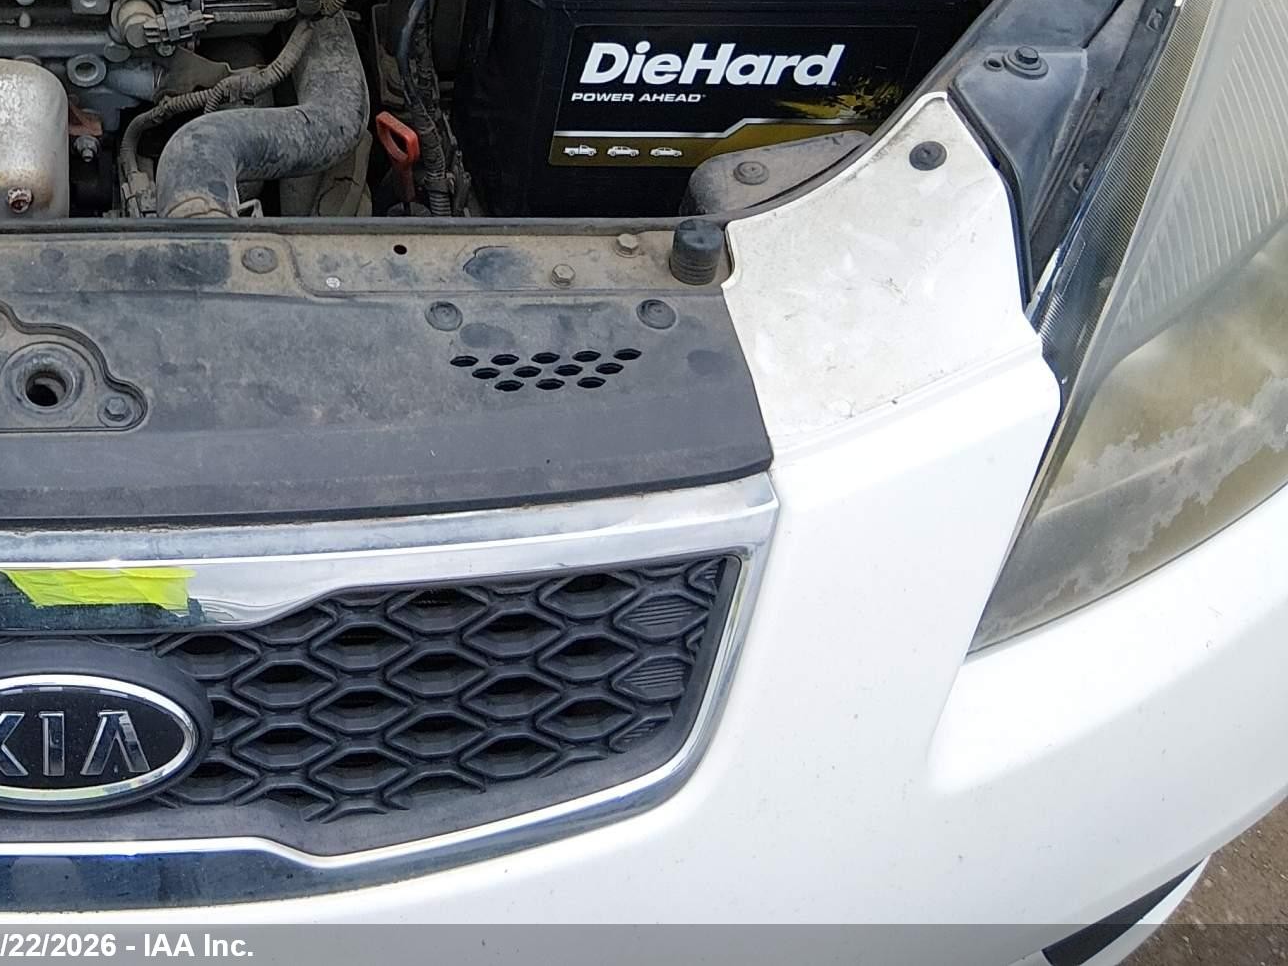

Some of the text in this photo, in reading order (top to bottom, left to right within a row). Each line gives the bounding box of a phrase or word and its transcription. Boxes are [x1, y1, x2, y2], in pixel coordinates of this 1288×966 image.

[579, 40, 846, 86] DieHard
[571, 93, 702, 102] POWER AHEAD
